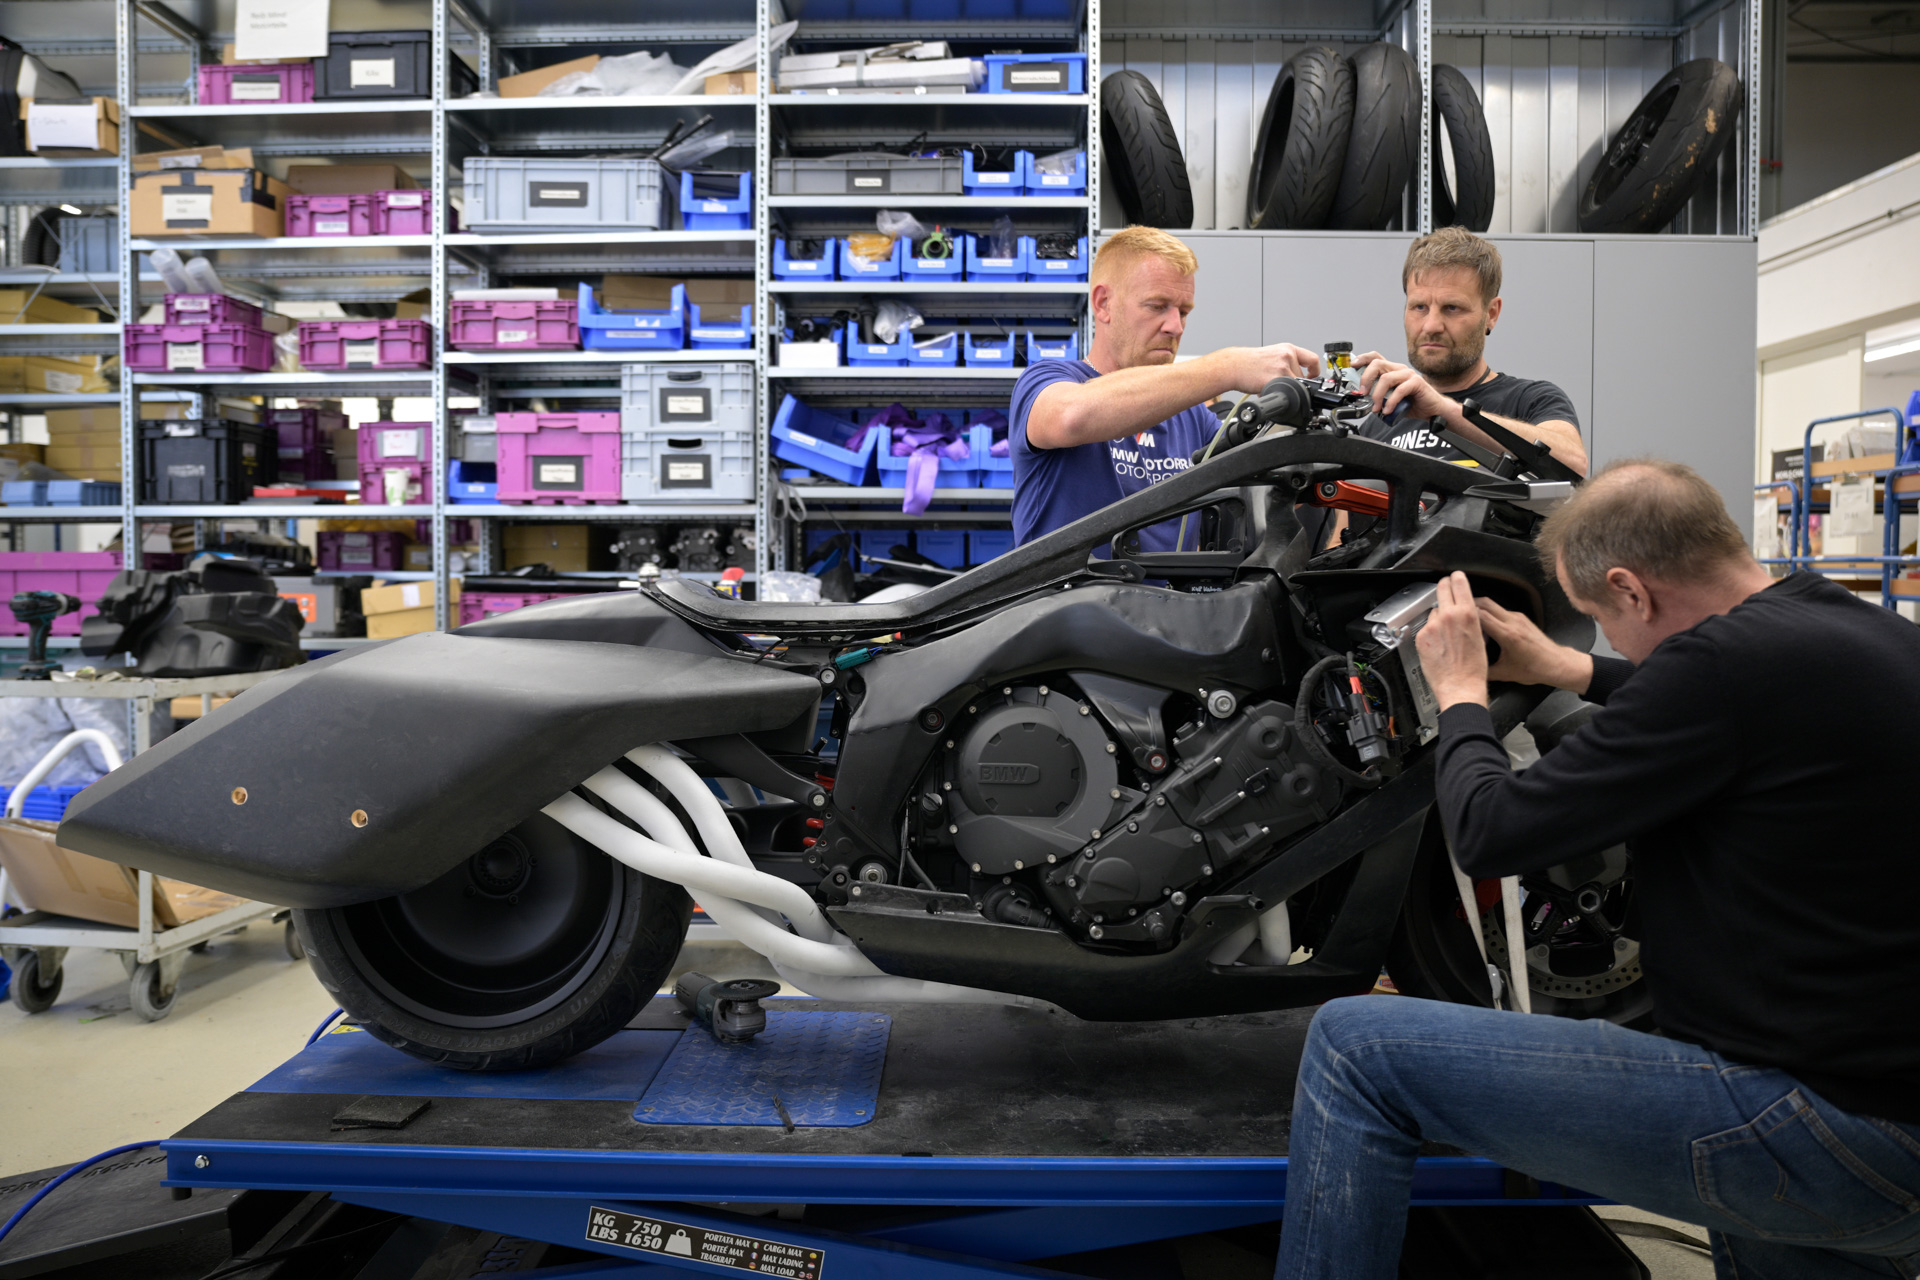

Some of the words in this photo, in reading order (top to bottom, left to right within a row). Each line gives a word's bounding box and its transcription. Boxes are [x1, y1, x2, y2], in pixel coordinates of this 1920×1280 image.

[1390, 428, 1452, 450] PINES
[1110, 447, 1139, 463] MW
[1143, 457, 1195, 471] OTORR
[980, 766, 1028, 781] BMW
[458, 1014, 567, 1048] MARATHON
[592, 1212, 616, 1228] KG
[630, 1220, 662, 1236] 750
[590, 1225, 619, 1241] LBS
[624, 1232, 662, 1250] 1650
[703, 1232, 734, 1245] PORTATA
[735, 1238, 751, 1248] MAX
[728, 1247, 745, 1258] MAX
[763, 1243, 786, 1255] CARGA
[787, 1248, 803, 1258] MAX
[700, 1252, 736, 1266] TRAGKRAFT
[762, 1254, 778, 1264] MAX
[779, 1257, 804, 1269] LADING
[760, 1263, 776, 1274] MAX
[776, 1267, 796, 1277] LOAD
